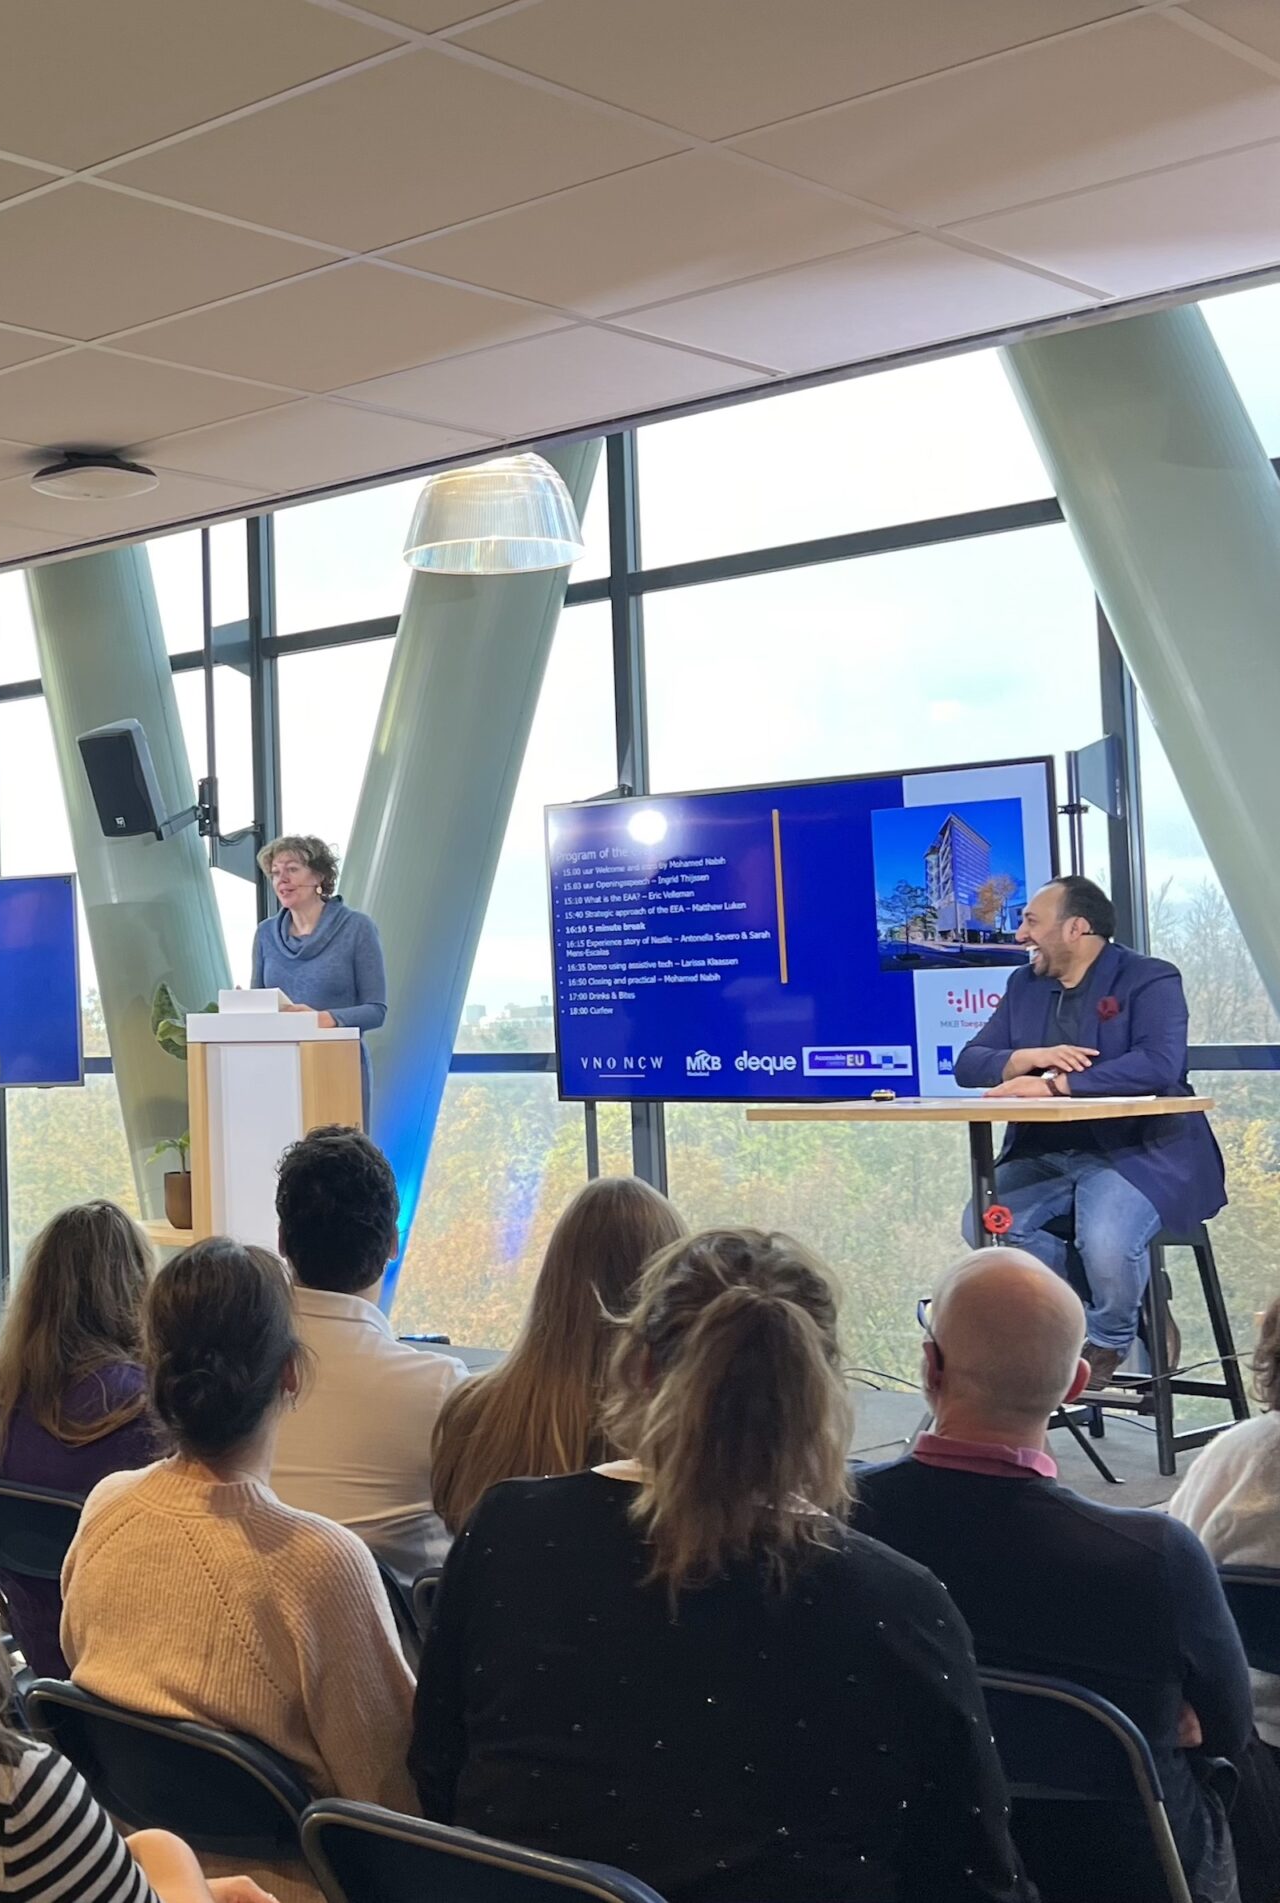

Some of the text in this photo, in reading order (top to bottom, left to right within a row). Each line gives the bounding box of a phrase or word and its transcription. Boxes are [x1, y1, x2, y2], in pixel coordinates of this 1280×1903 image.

[556, 850, 596, 864] Program
[599, 848, 609, 859] of
[595, 865, 624, 874] Welcome
[669, 859, 703, 869] Mohamed
[705, 856, 726, 866] Nabih
[658, 875, 679, 886] Ingrid
[584, 895, 602, 904] What
[603, 895, 609, 903] is
[610, 894, 621, 903] the
[623, 892, 641, 901] EAA?
[648, 891, 662, 900] Eric
[584, 909, 614, 919] Strategic
[615, 906, 647, 918] approach
[648, 906, 656, 915] of
[656, 905, 668, 914] the
[692, 902, 723, 912] Matthew
[565, 922, 646, 934] 16:10 5 minute break
[586, 938, 622, 948] Experience
[623, 937, 641, 947] story
[642, 936, 650, 945] of
[749, 930, 771, 940] Sarah
[587, 963, 607, 971] Demo
[609, 962, 627, 972] using
[658, 960, 673, 969] tech
[588, 977, 613, 987] Closing
[613, 976, 627, 985] and
[627, 975, 657, 986] practical
[663, 974, 699, 984] Mohamed
[700, 973, 721, 982] Nabih
[589, 991, 610, 1001] Drinks
[686, 1052, 722, 1071] MKB
[734, 1050, 797, 1076] deque
[846, 1053, 865, 1067] EU
